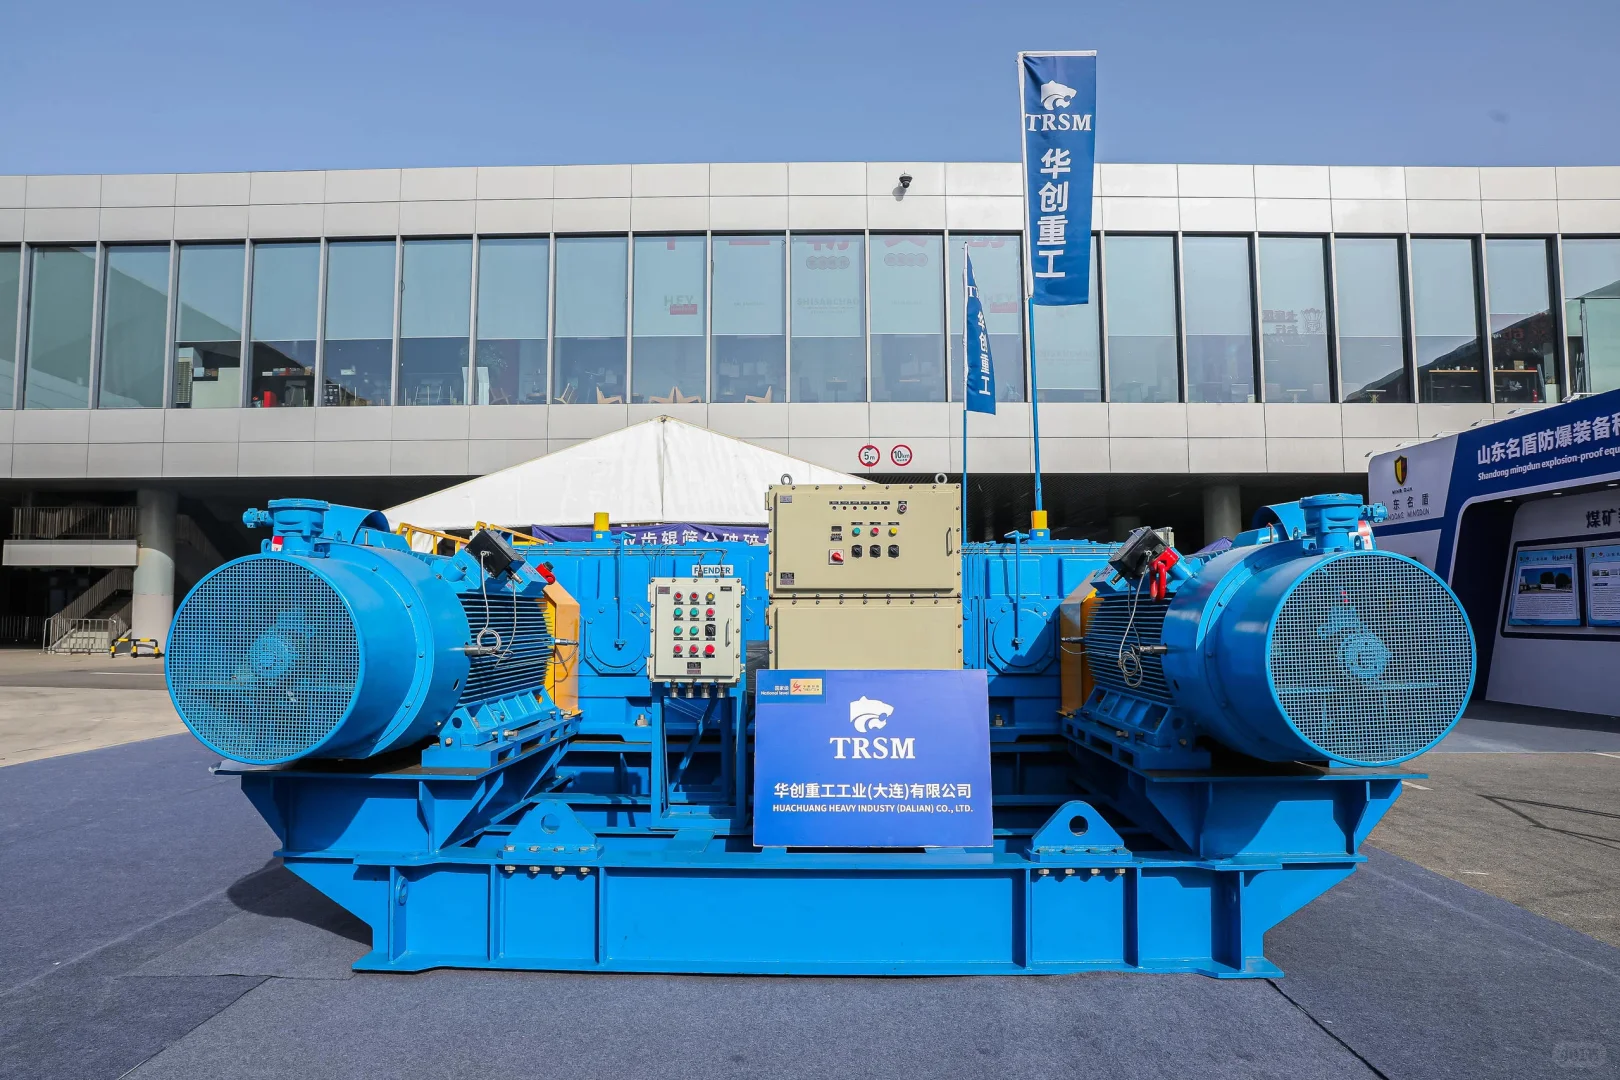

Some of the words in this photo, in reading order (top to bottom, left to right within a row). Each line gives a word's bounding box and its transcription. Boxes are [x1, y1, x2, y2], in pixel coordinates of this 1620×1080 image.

[1025, 113, 1092, 131] TRSM
[1035, 148, 1071, 278] 华创重工
[1478, 469, 1509, 480] Shandong
[1510, 462, 1540, 474] mingdun
[1541, 447, 1603, 469] explosion-proof
[1586, 508, 1620, 528] 煤矿
[830, 737, 916, 759] TRSM
[773, 783, 971, 800] 华创重工工业(大连)有限公司
[773, 804, 827, 812] HUACHUANG
[829, 804, 856, 812] HEAVY
[858, 804, 895, 812] INDUSTY
[897, 804, 934, 813] (DALIAN)
[936, 804, 954, 813] CO.,
[955, 804, 974, 812] LTD.
